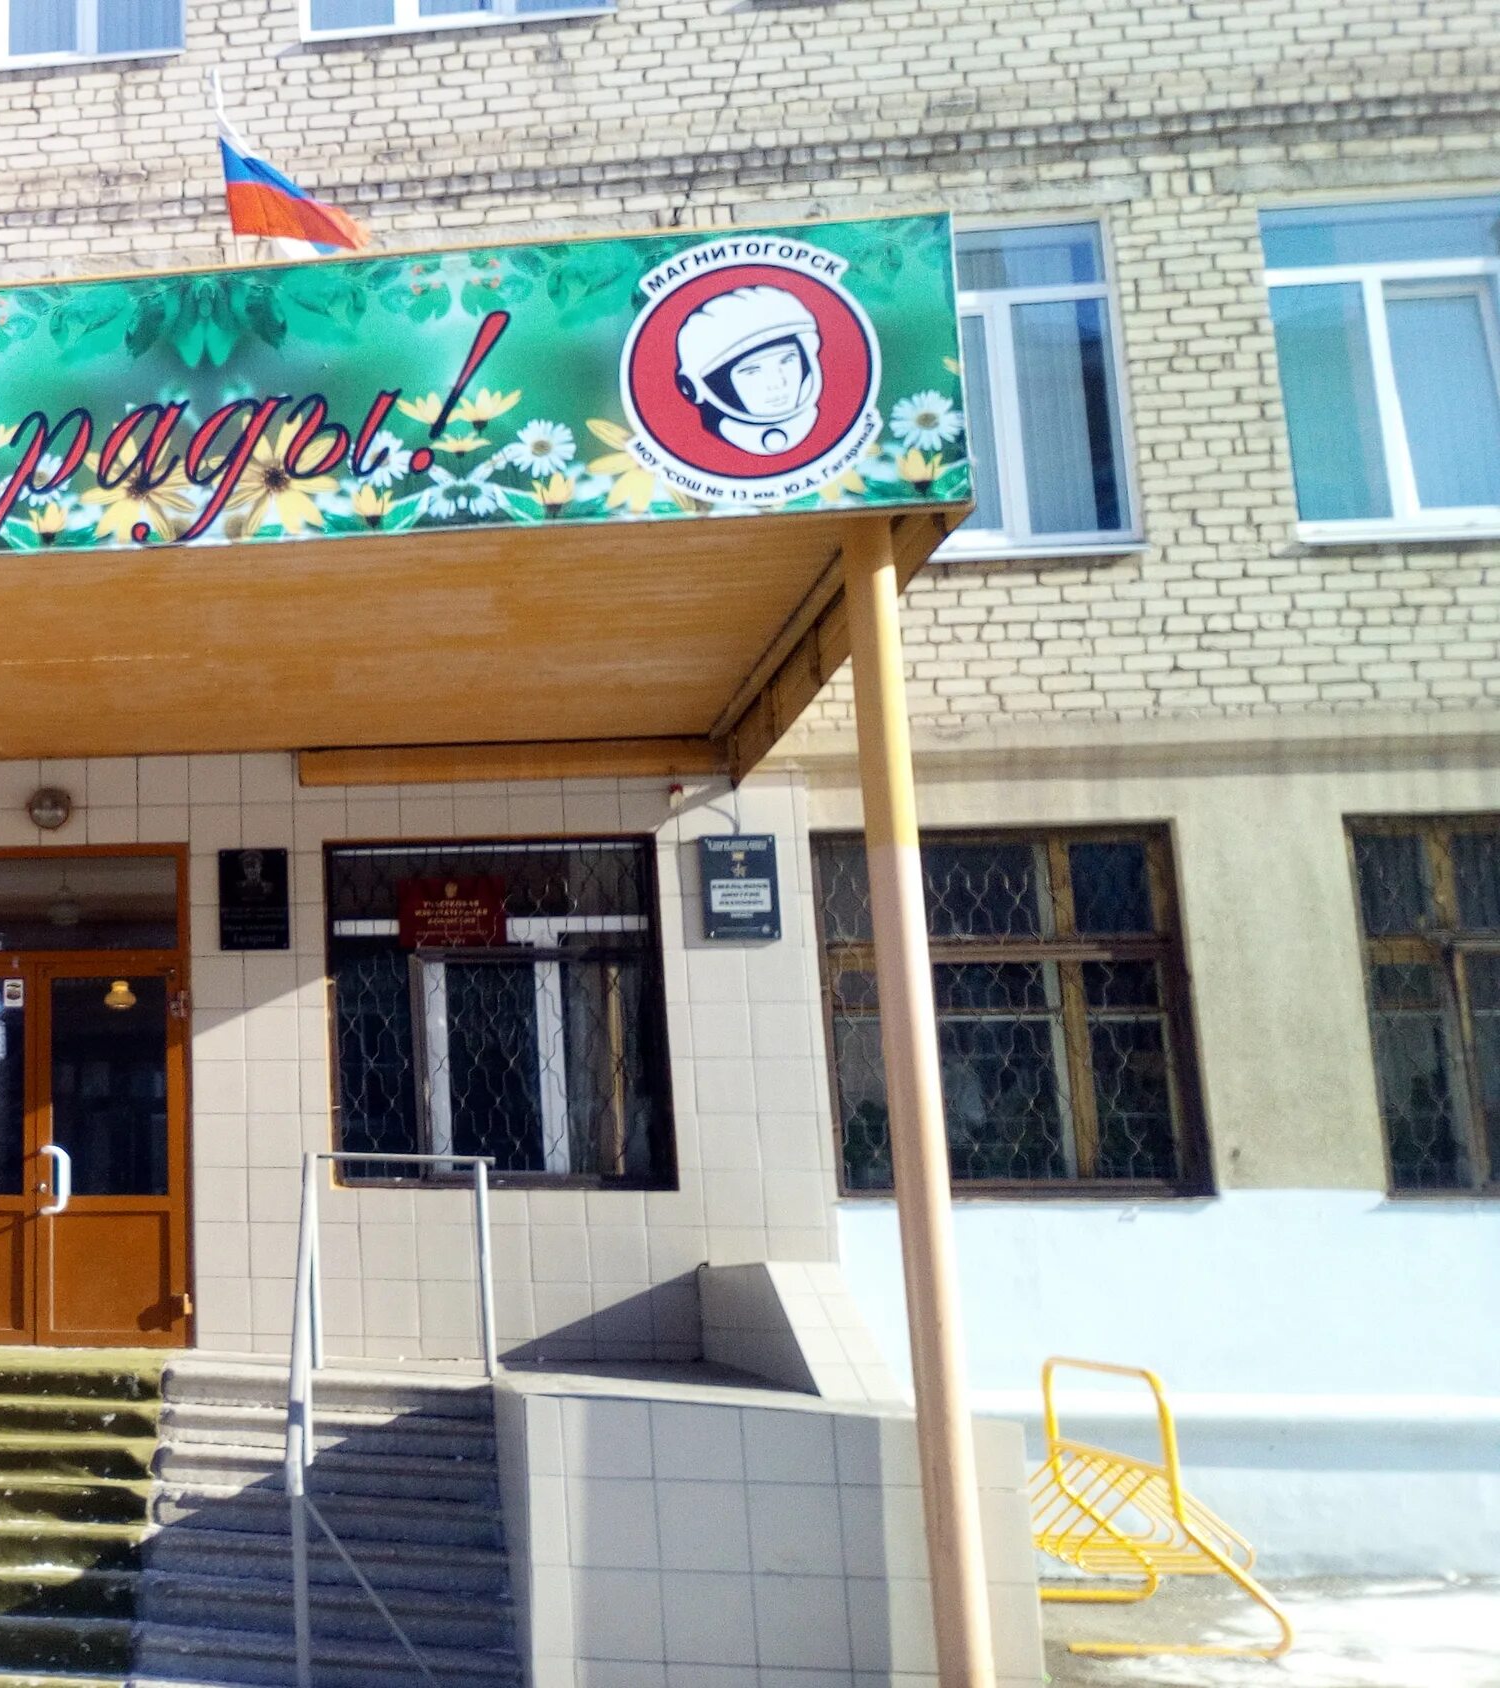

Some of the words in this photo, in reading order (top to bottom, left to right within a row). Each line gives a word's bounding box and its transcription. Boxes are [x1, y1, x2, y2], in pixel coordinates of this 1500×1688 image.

[647, 243, 843, 292] МАГНИТОГОРСК
[633, 441, 660, 467] МОУ
[731, 489, 748, 501] 13
